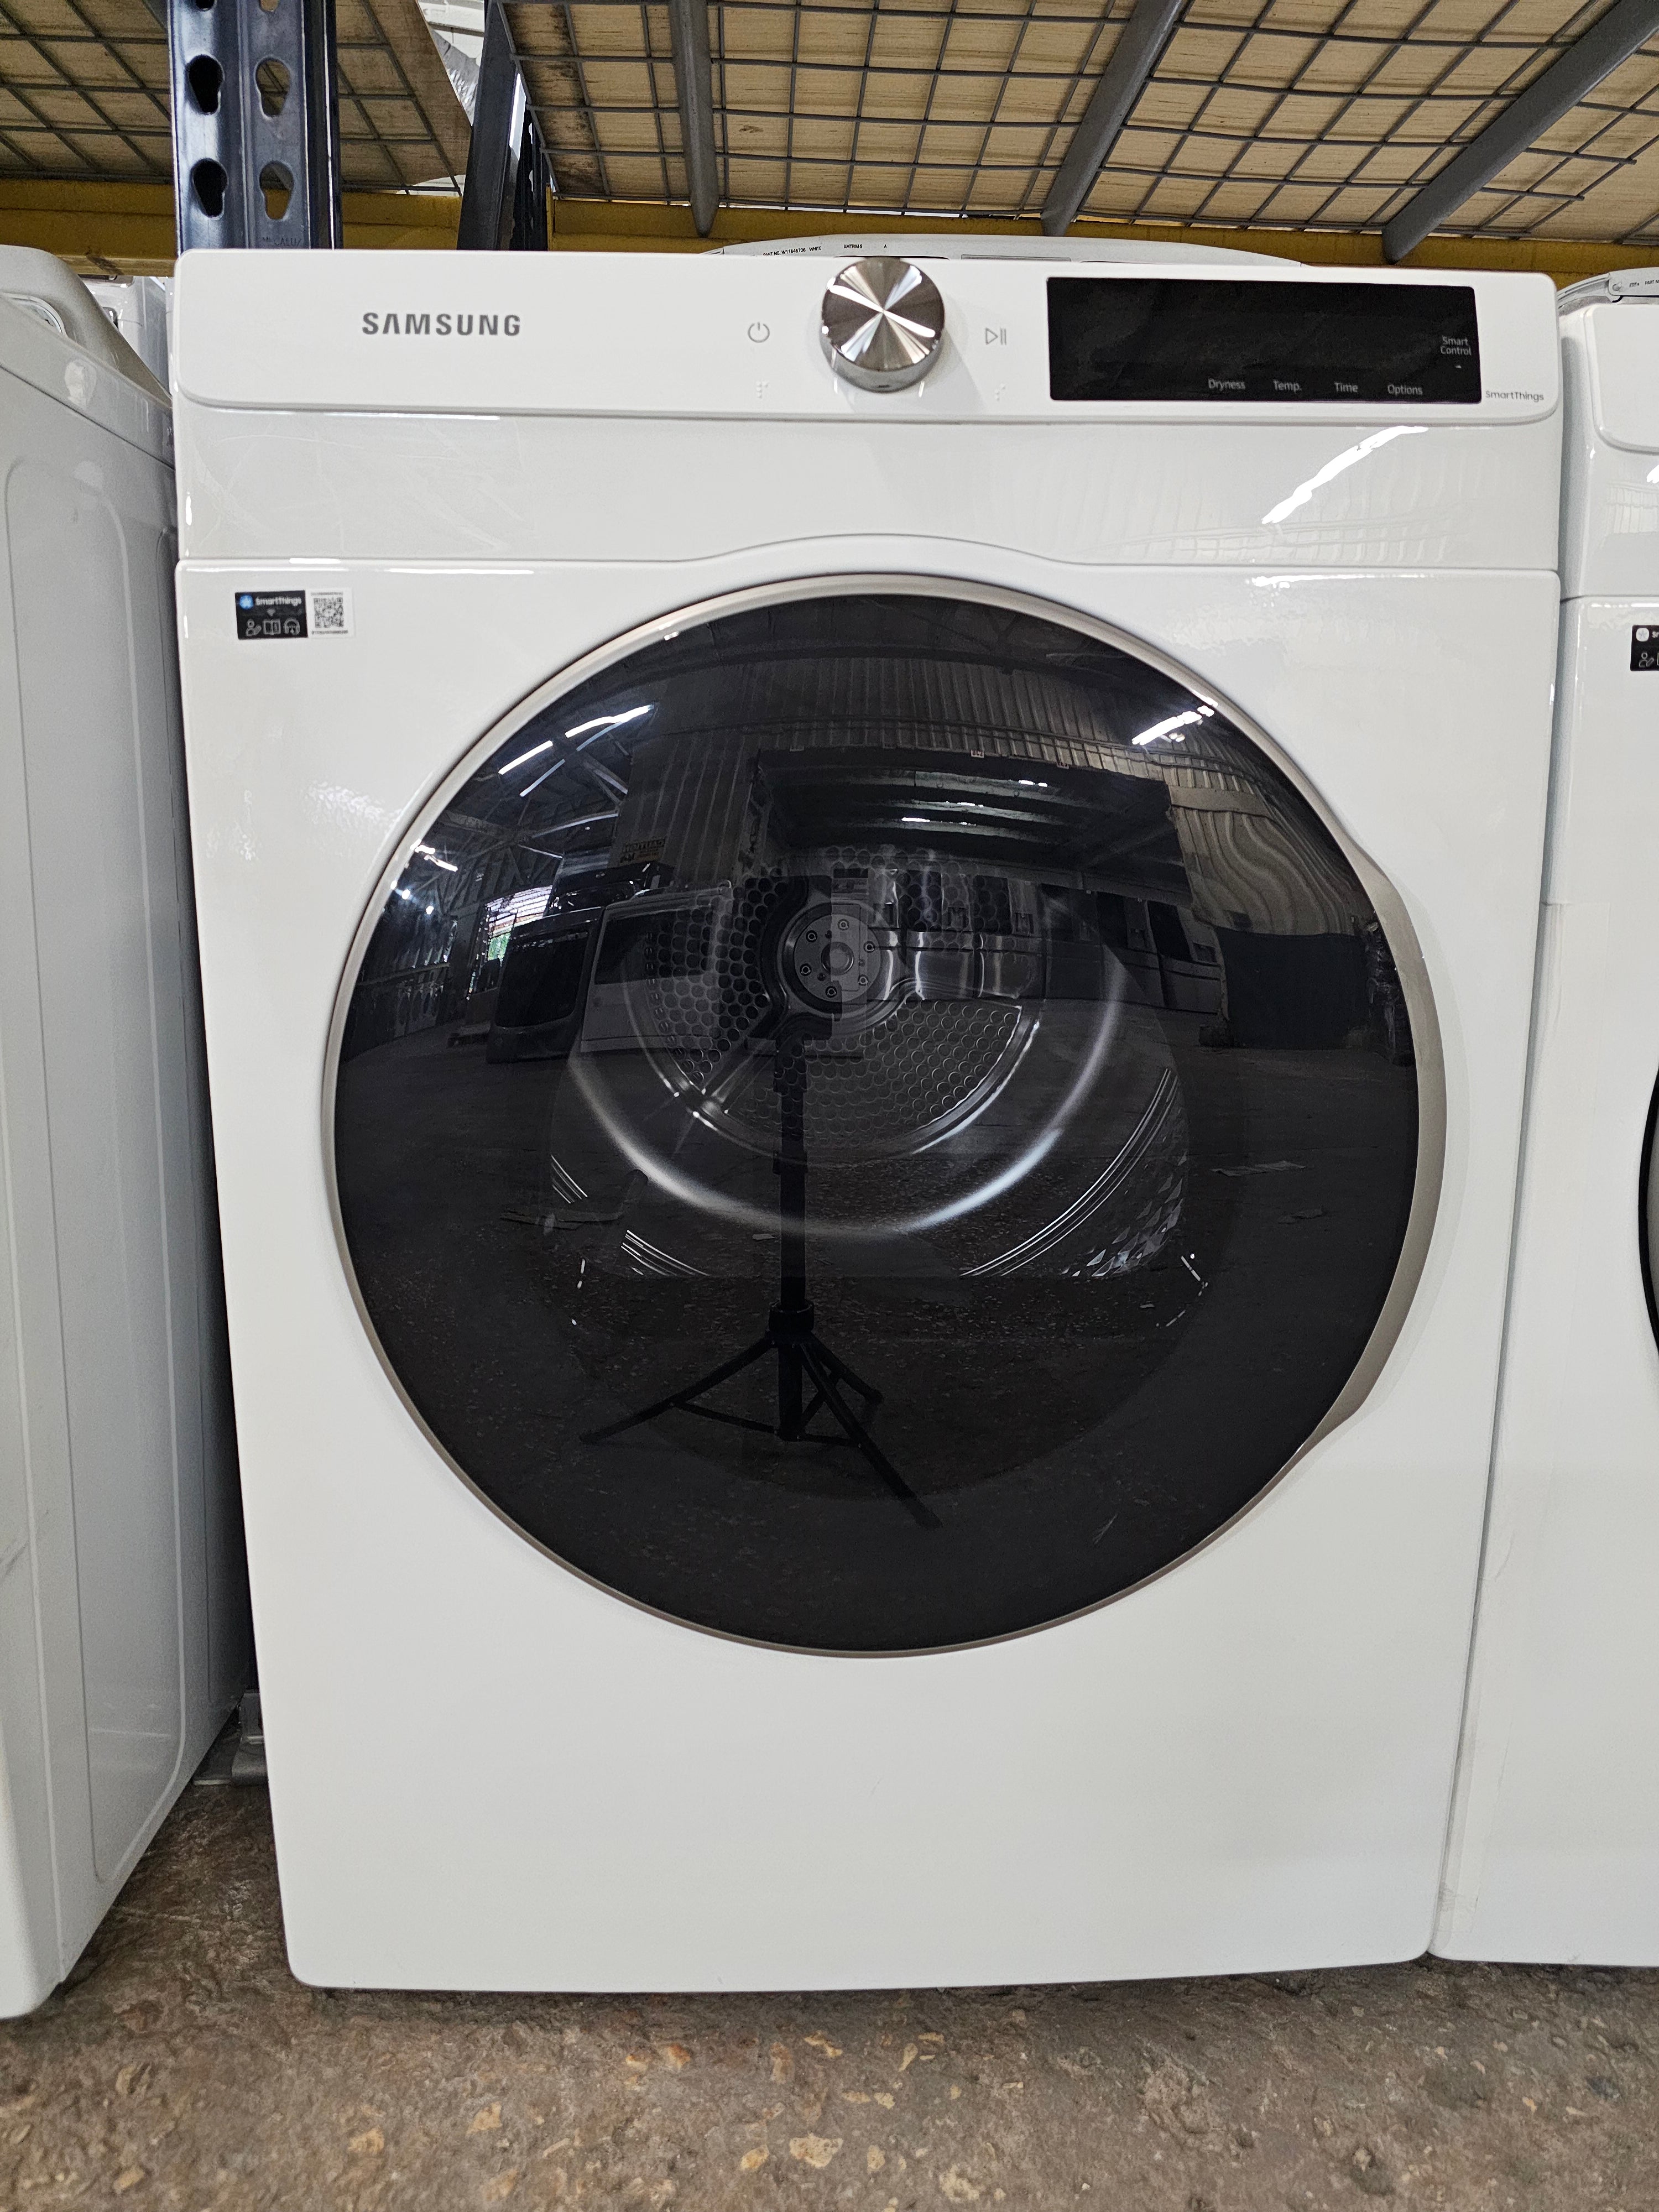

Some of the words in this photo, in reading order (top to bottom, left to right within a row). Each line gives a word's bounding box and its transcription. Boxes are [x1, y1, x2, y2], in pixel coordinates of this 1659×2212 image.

[362, 312, 520, 336] SAMSUNG
[1442, 335, 1468, 346] Smart
[1440, 345, 1472, 356] Control
[1208, 378, 1245, 391] Dryness
[1273, 379, 1302, 393] Temp.
[1333, 381, 1358, 393] Time
[1387, 384, 1423, 396] Options
[1485, 390, 1545, 403] SmartThings
[255, 596, 302, 606] SmartThings
